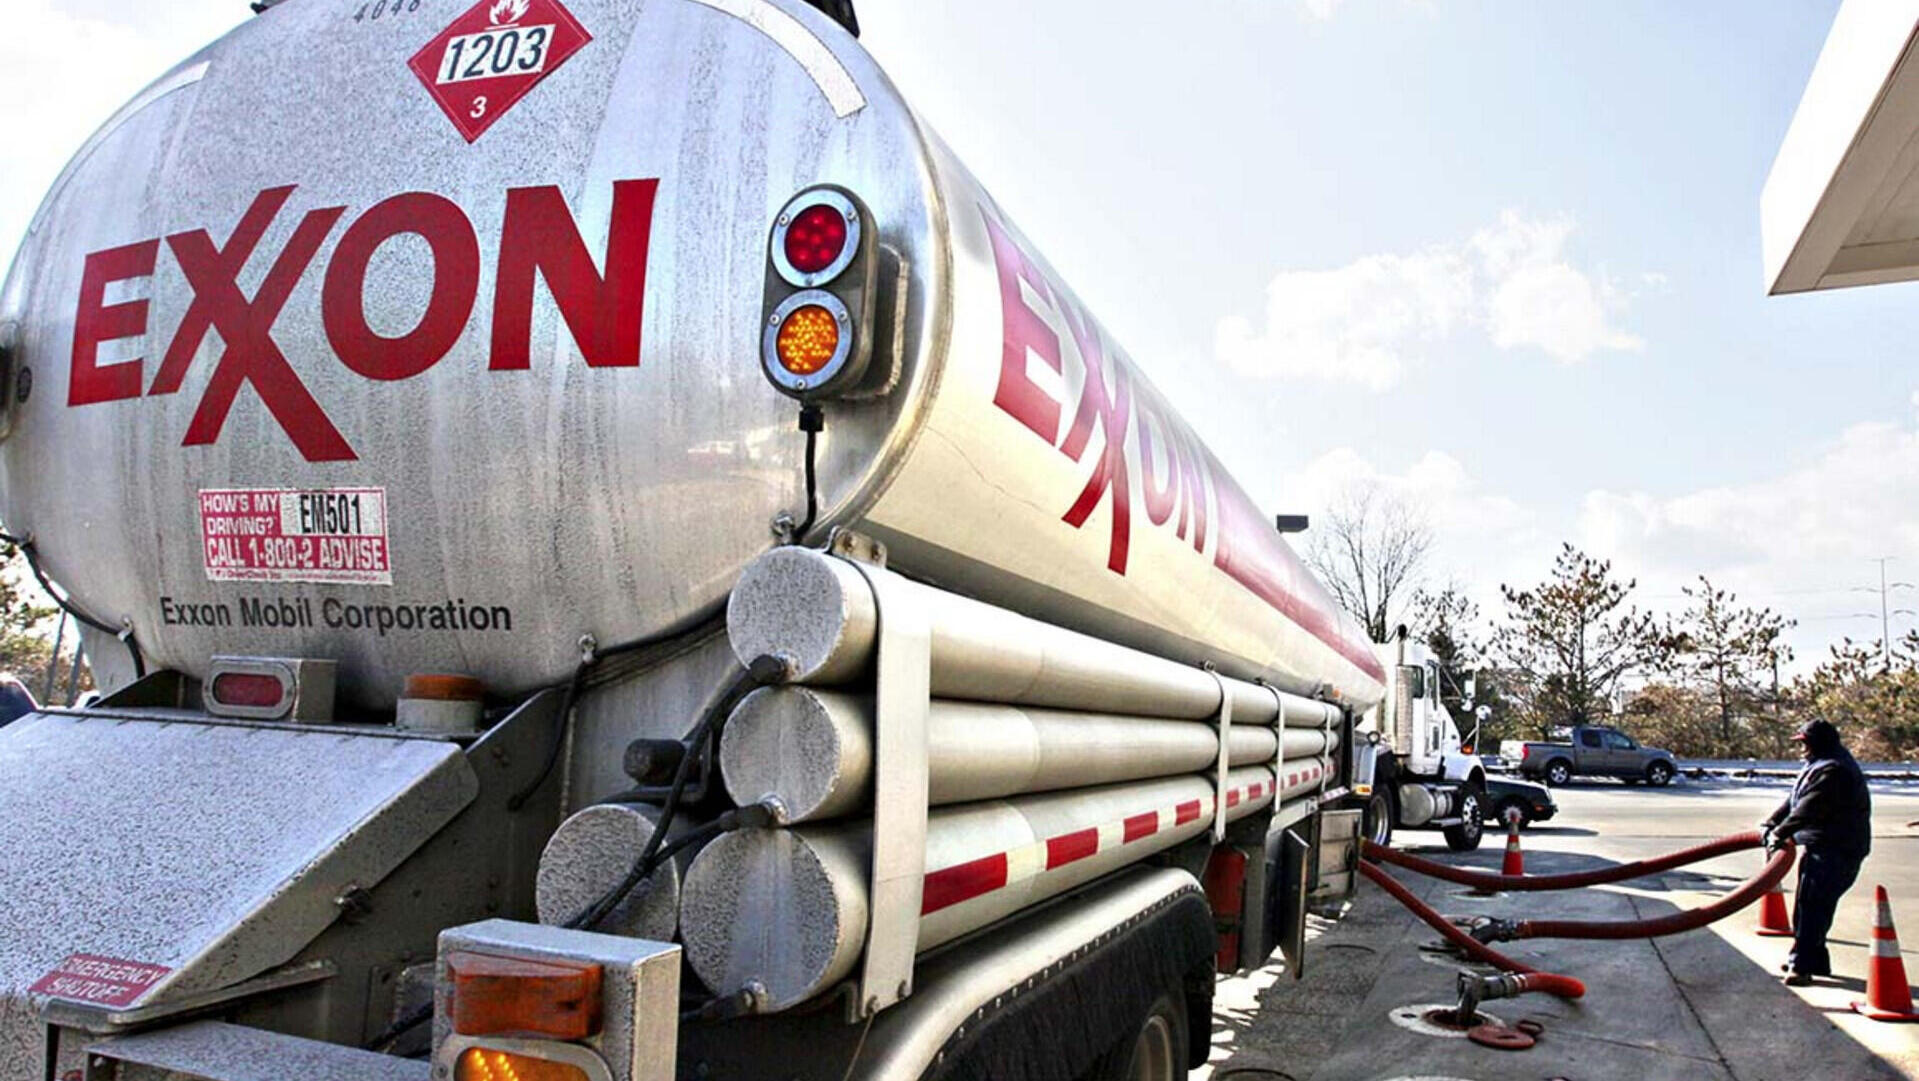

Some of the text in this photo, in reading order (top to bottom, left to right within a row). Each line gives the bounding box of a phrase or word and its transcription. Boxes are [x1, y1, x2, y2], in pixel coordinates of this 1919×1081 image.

[447, 27, 547, 80] 1203
[470, 96, 487, 118] 3
[67, 178, 660, 462] EXXON
[976, 201, 1208, 577] EXXON
[202, 493, 280, 512] HOW'S MY
[300, 493, 362, 534] EM501
[206, 516, 274, 535] DRIVING?
[207, 537, 385, 569] CALL 1-800-2 ADVISE
[160, 597, 512, 637] Exxon Mobil Corporation
